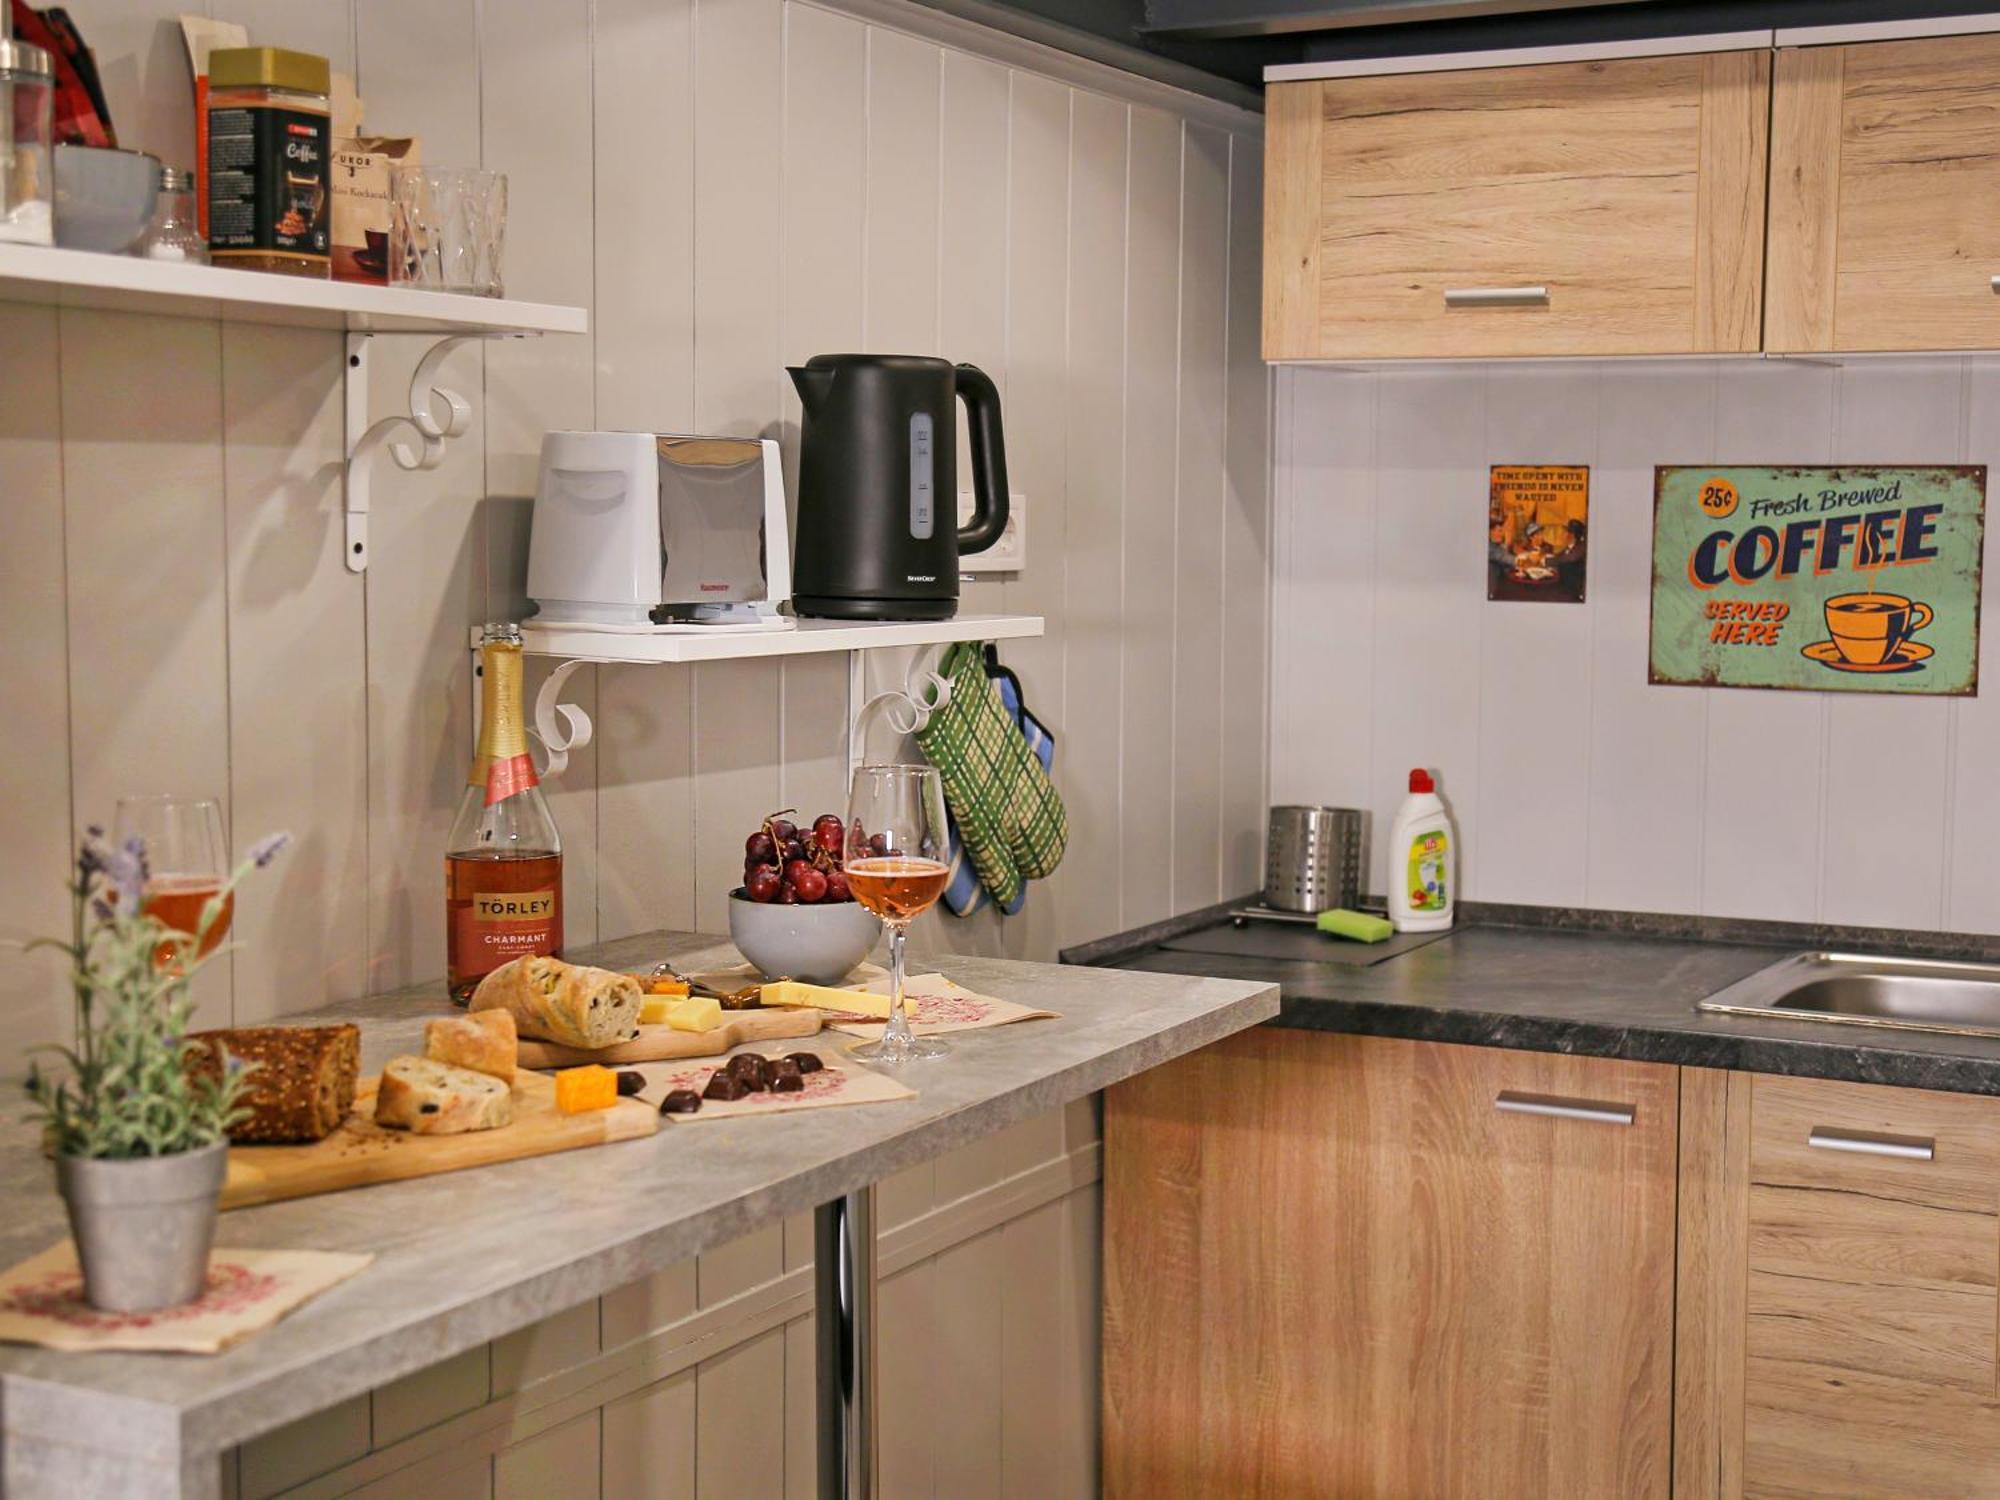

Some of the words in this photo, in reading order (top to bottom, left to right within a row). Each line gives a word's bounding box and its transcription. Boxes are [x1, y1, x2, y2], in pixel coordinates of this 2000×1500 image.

[1750, 493, 1812, 519] Fresh
[1818, 480, 1902, 512] Brewed
[1690, 503, 1944, 588] COFFEE
[1705, 600, 1790, 621] SERVED
[1710, 620, 1783, 646] HERE
[479, 899, 549, 914] TÖRLEY
[484, 933, 546, 944] CHARMANT
